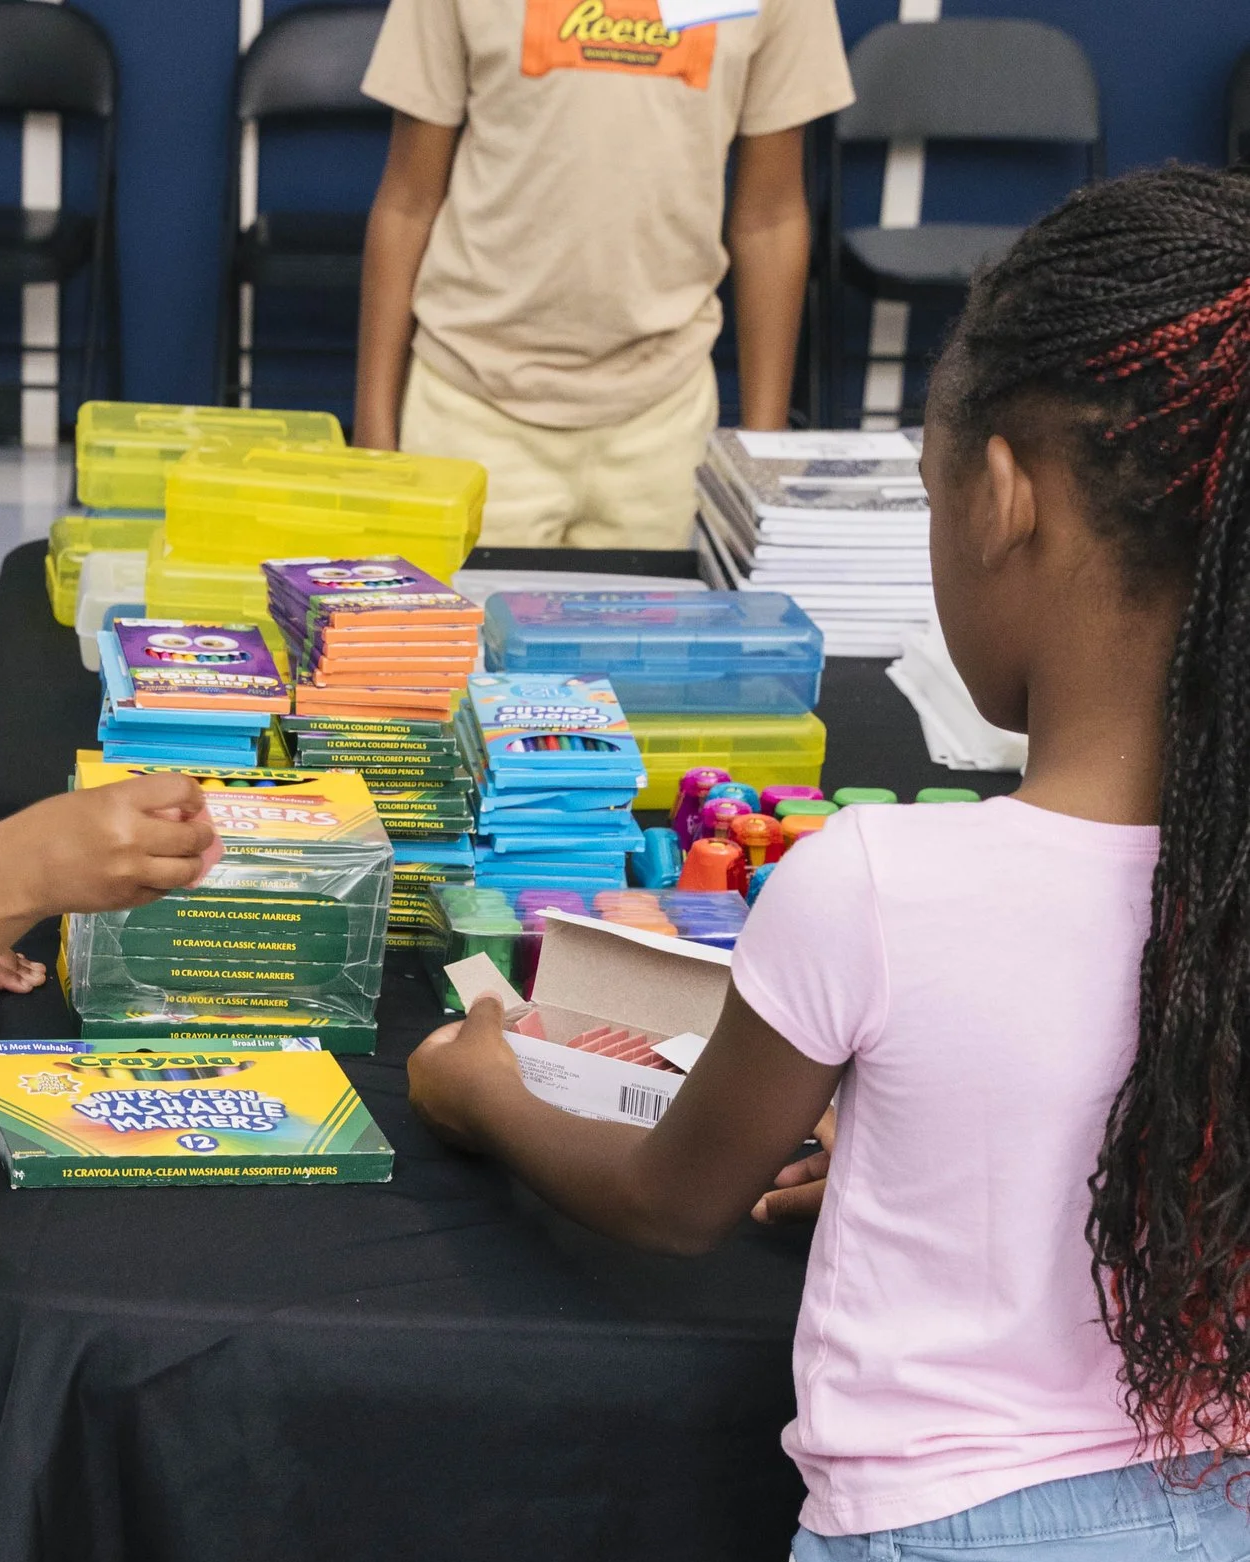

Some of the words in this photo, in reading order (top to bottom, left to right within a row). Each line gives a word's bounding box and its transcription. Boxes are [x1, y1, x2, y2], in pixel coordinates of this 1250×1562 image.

[318, 723, 350, 731] CRAYOLA
[351, 724, 383, 732] COLORED
[384, 725, 411, 733] PENCILS
[400, 742, 427, 750] PENCILS
[372, 755, 403, 763] COLORED
[404, 755, 431, 763] PENCILS
[411, 803, 437, 811] PENCILS
[209, 804, 339, 826] RKERS
[384, 820, 417, 828] COLORED
[418, 821, 444, 829] PENCILS
[230, 847, 264, 855] CLASSIC
[265, 848, 303, 857] MARKERS
[225, 879, 257, 888] CLASSIC
[187, 910, 226, 918] CRAYOLA
[228, 911, 260, 920] CLASSIC
[262, 913, 301, 922] MARKERS
[173, 939, 181, 947] 10
[183, 939, 221, 948] CRAYOLA
[223, 941, 256, 949] CLASSIC
[258, 942, 296, 950] MARKERS
[171, 969, 180, 977] 10
[181, 970, 220, 978] CRAYOLA
[222, 971, 254, 979] CLASSIC
[256, 972, 295, 980] MARKERS
[166, 995, 175, 1003] 10
[176, 996, 214, 1005] CRAYOLA
[216, 997, 248, 1005] CLASSIC
[250, 998, 289, 1007] MARKERS
[9, 1043, 31, 1051] Most
[33, 1043, 74, 1052] Washable
[71, 1054, 235, 1068] Crayola
[92, 1089, 258, 1102] ULTRA-CLEAN
[74, 1099, 285, 1119] WASHABLE
[108, 1115, 275, 1132] MARKERS
[181, 1135, 216, 1150] 12
[62, 1169, 73, 1177] 12
[74, 1169, 120, 1177] CRAYOLA
[122, 1168, 187, 1177] ULTRA-CLEAN
[189, 1168, 240, 1176] WASHABLE
[242, 1167, 291, 1176] ASSORTED
[293, 1167, 338, 1176] MARKERS
